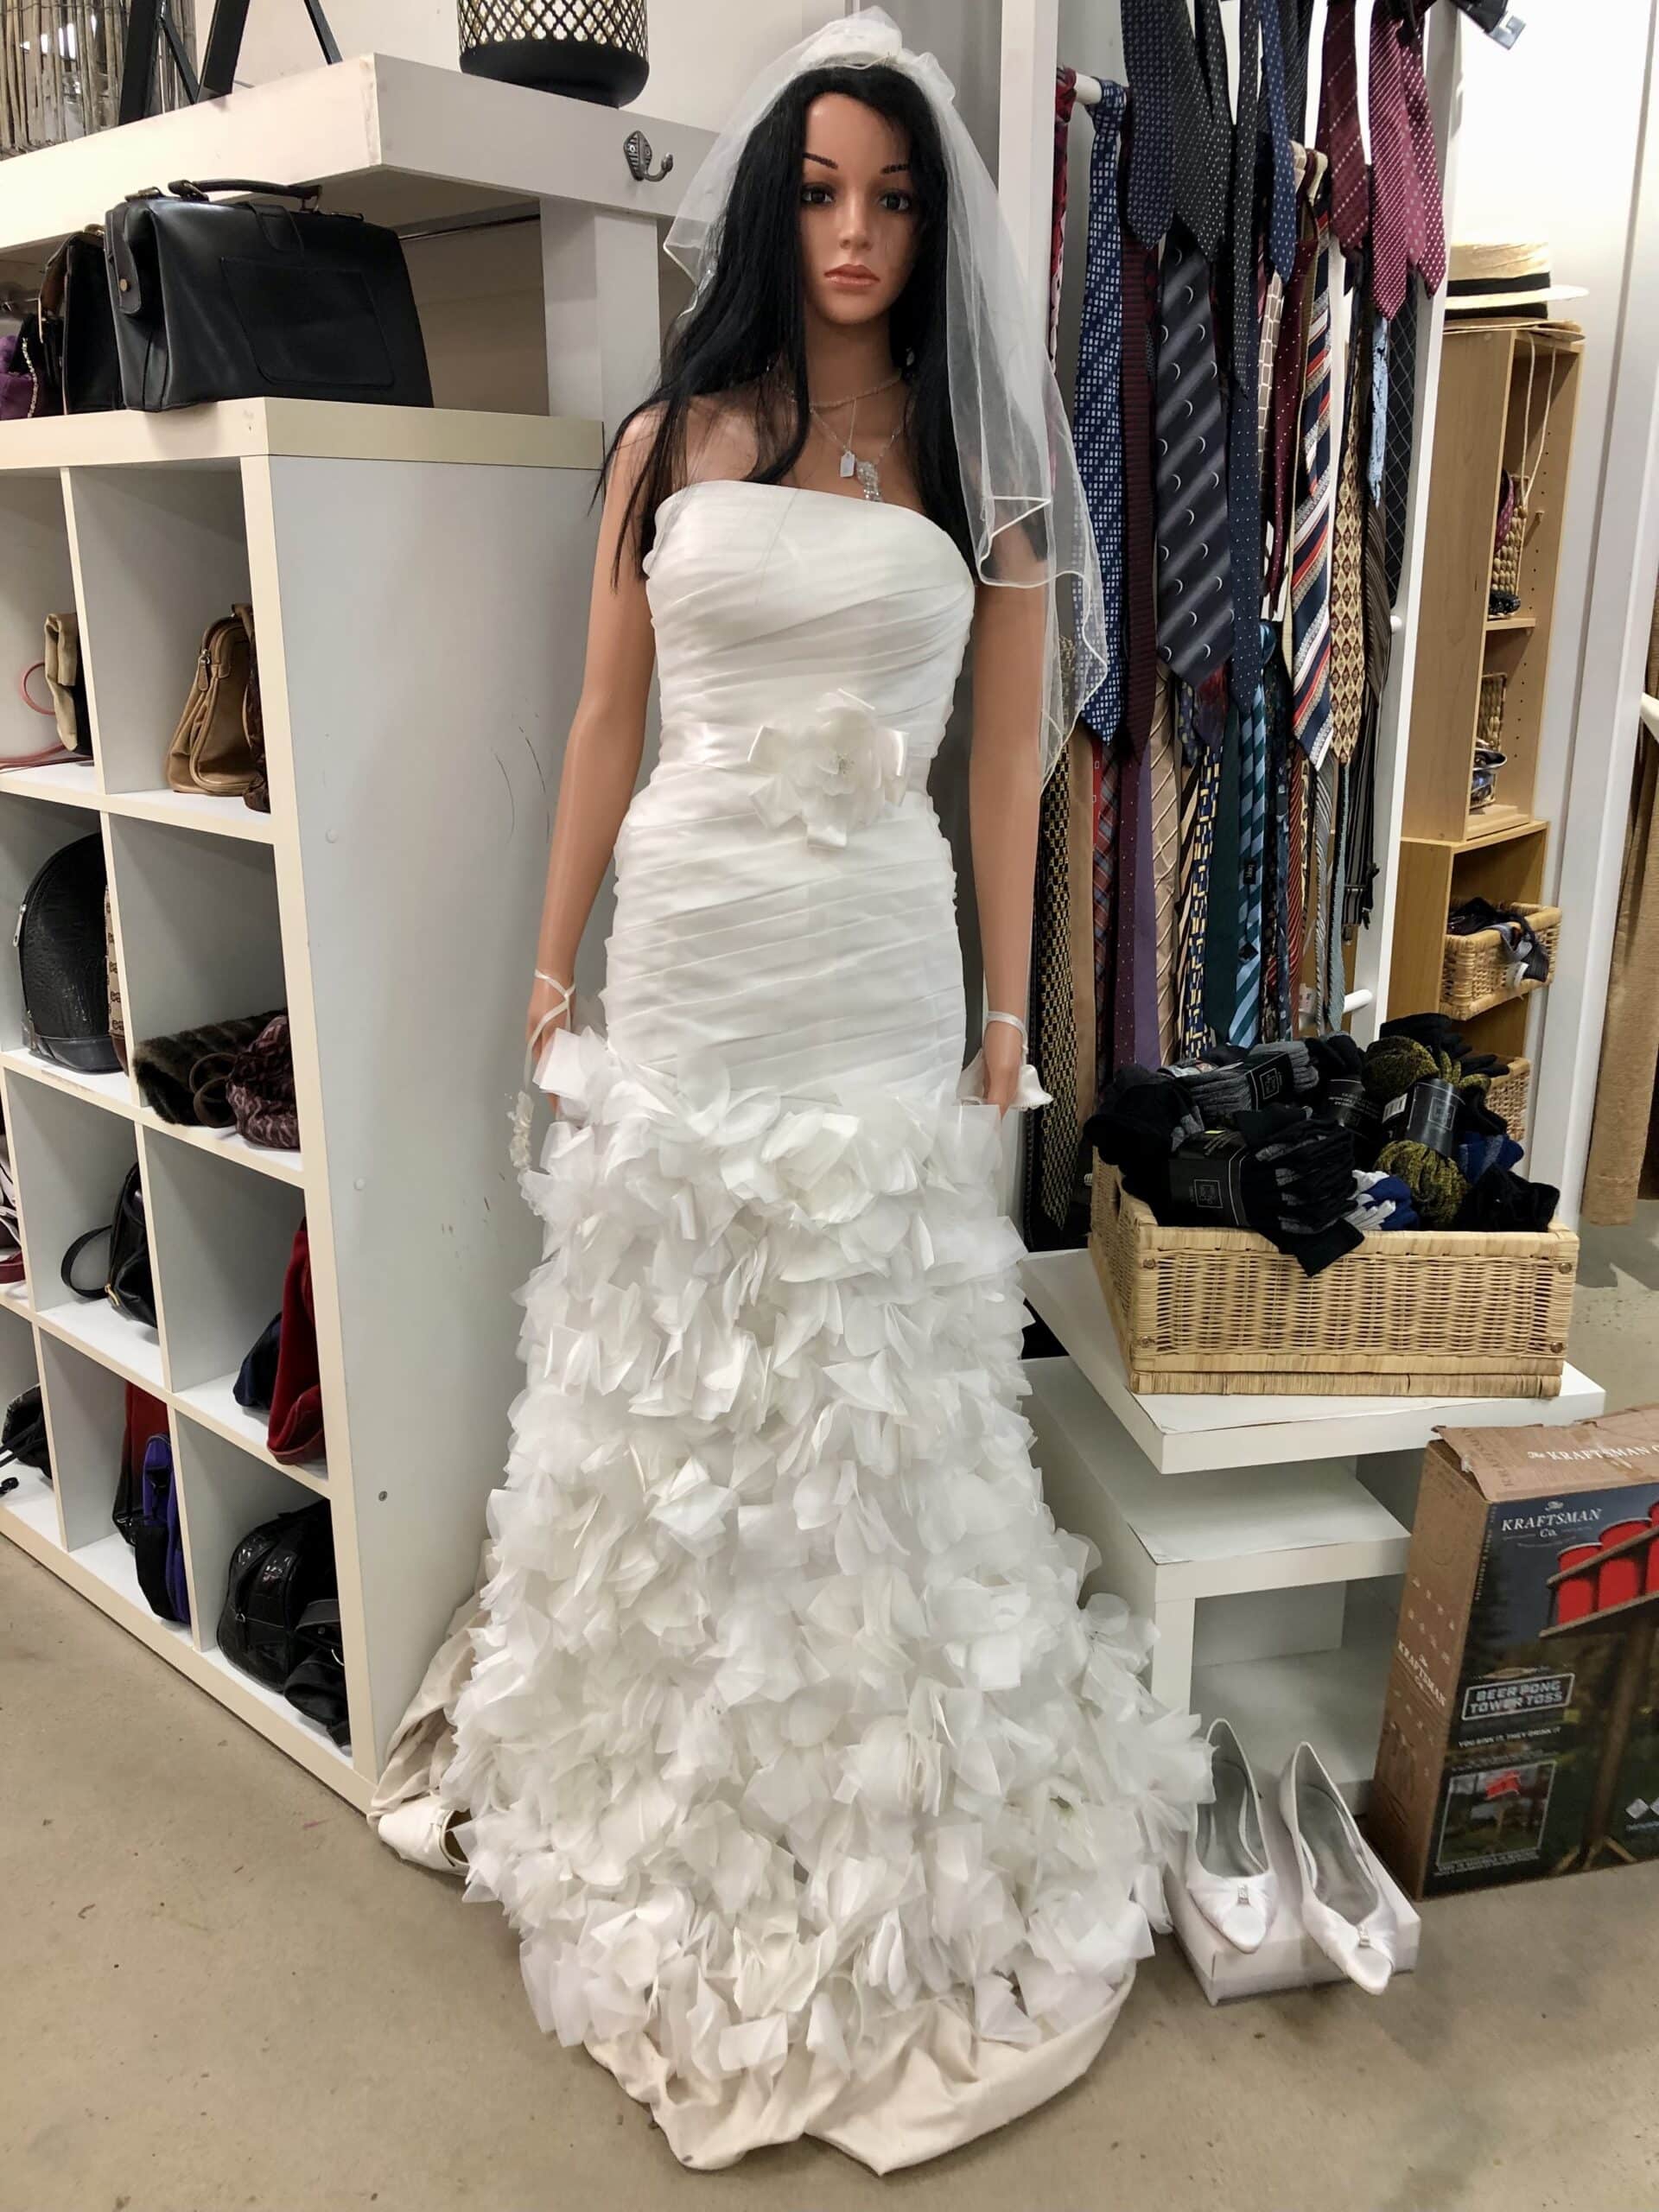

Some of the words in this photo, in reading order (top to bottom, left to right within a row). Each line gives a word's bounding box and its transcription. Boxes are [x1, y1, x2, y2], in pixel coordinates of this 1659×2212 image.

[1546, 1446, 1651, 1460] KRAFTSMAN
[1502, 1508, 1602, 1531] KRAFTSMAN
[1476, 1686, 1518, 1701] BEER
[1520, 1680, 1561, 1695] PONG
[1470, 1696, 1523, 1714] TOWER
[1525, 1690, 1563, 1707] TOSS
